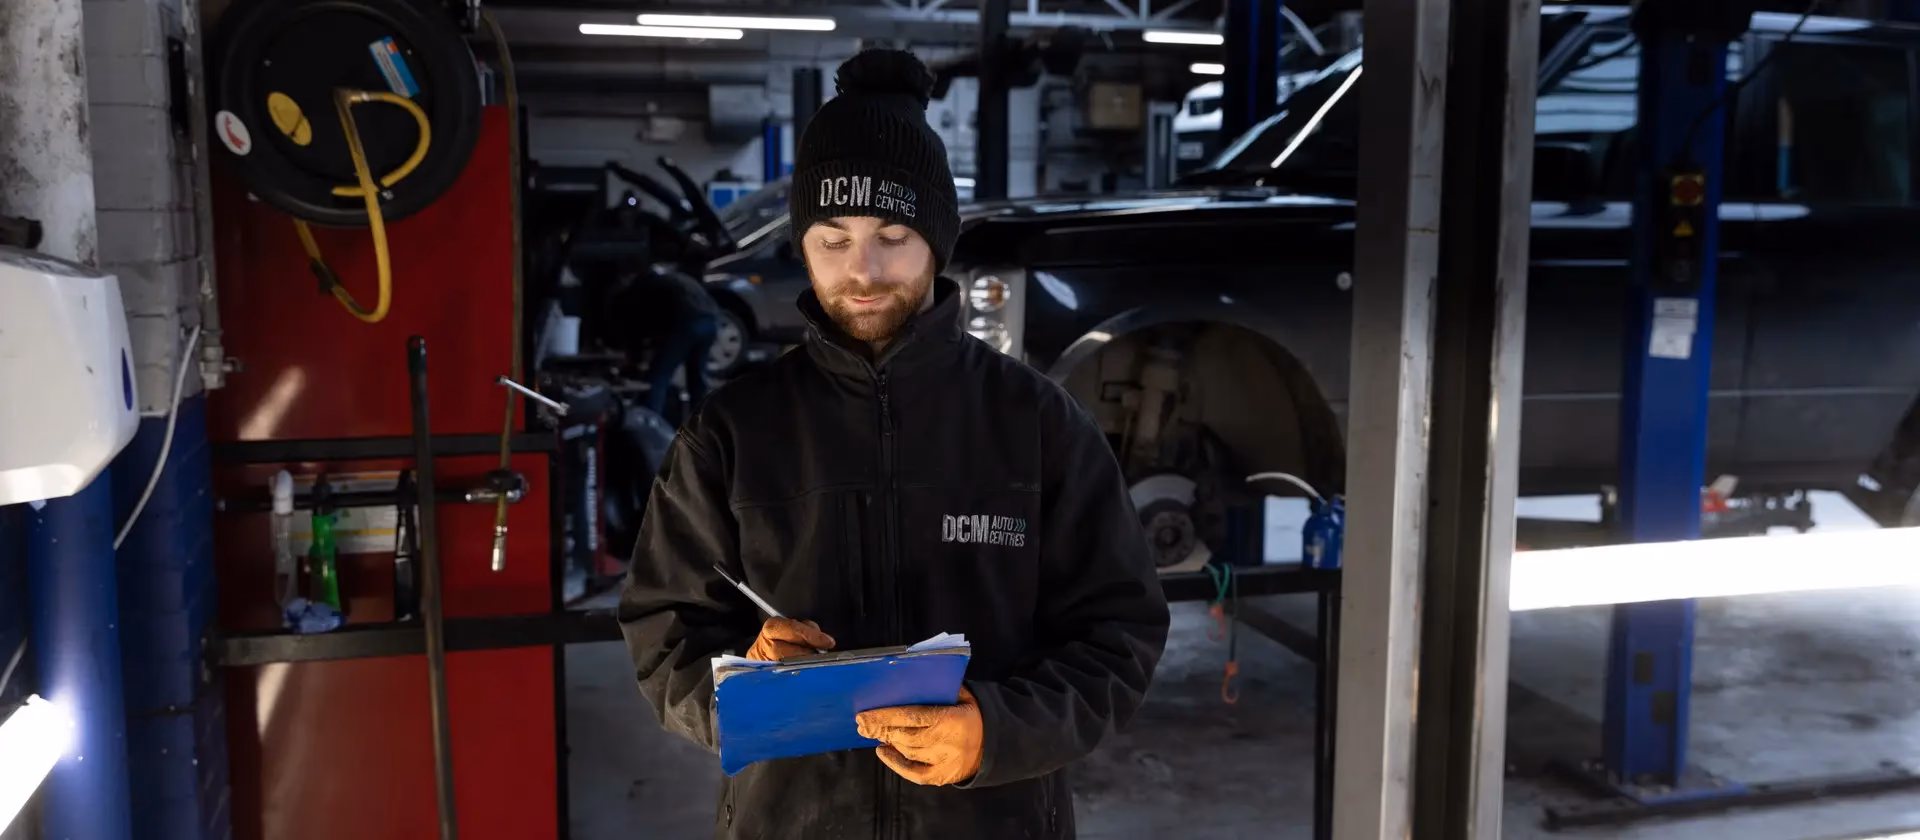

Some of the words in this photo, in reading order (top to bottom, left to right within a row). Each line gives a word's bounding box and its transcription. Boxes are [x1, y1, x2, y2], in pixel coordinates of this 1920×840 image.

[820, 175, 872, 207] DCM
[878, 180, 904, 198] AUTO
[875, 194, 916, 218] CENTRES
[942, 514, 990, 543] DCM
[991, 515, 1014, 531] AUTO
[989, 530, 1025, 547] CENTRES
